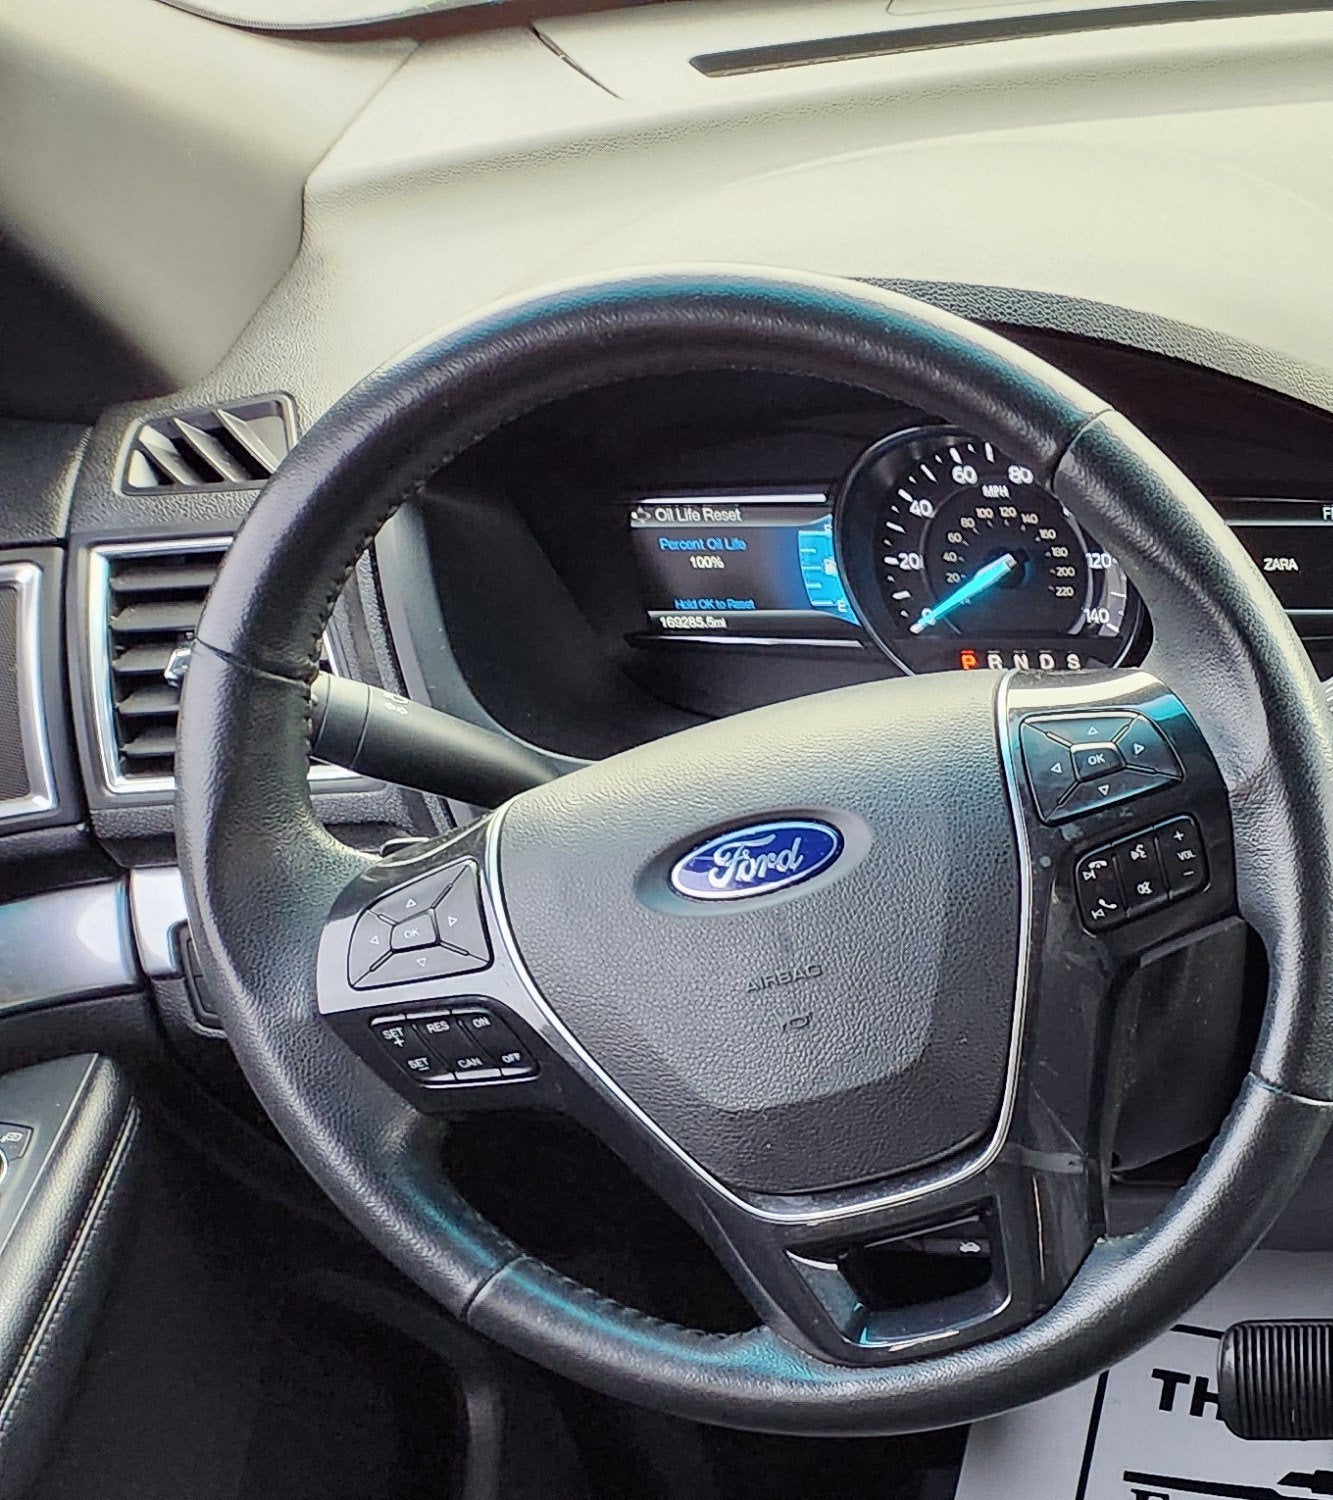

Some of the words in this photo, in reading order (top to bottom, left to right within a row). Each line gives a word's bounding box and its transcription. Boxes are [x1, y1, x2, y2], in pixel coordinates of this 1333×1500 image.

[952, 466, 978, 484] 60
[1008, 466, 1034, 485] 80
[982, 485, 1011, 498] MPH
[655, 507, 674, 522] Oil
[675, 507, 701, 522] Life
[702, 507, 743, 522] Reset
[909, 500, 935, 518] 40
[975, 507, 994, 519] 100
[999, 506, 1017, 518] 120
[960, 517, 975, 529] 80
[1021, 513, 1039, 525] 140
[706, 537, 723, 550] Oil
[947, 532, 963, 544] 60
[943, 551, 958, 562] 40
[1051, 546, 1069, 558] 180
[689, 556, 725, 569] 100%
[898, 553, 920, 571] 20
[1086, 553, 1113, 569] 120
[1263, 558, 1299, 572] ZARA
[1056, 566, 1076, 577] 200
[946, 573, 961, 584] 20
[1055, 586, 1075, 598] 220
[1083, 608, 1110, 624] 140
[960, 652, 977, 670] P
[988, 653, 1003, 670] R
[1014, 653, 1030, 670] N
[1039, 653, 1056, 670] D
[1067, 653, 1082, 670] S
[1087, 753, 1105, 765] OK
[707, 834, 804, 889] Ford
[1176, 849, 1197, 862] VOL
[403, 928, 420, 940] OK
[747, 964, 825, 994] AIRBAG
[426, 1020, 450, 1034] RES
[472, 1017, 491, 1029] ON
[382, 1026, 403, 1040] SET
[408, 1056, 429, 1069] SET
[457, 1056, 483, 1069] CAN
[501, 1052, 521, 1064] OFF
